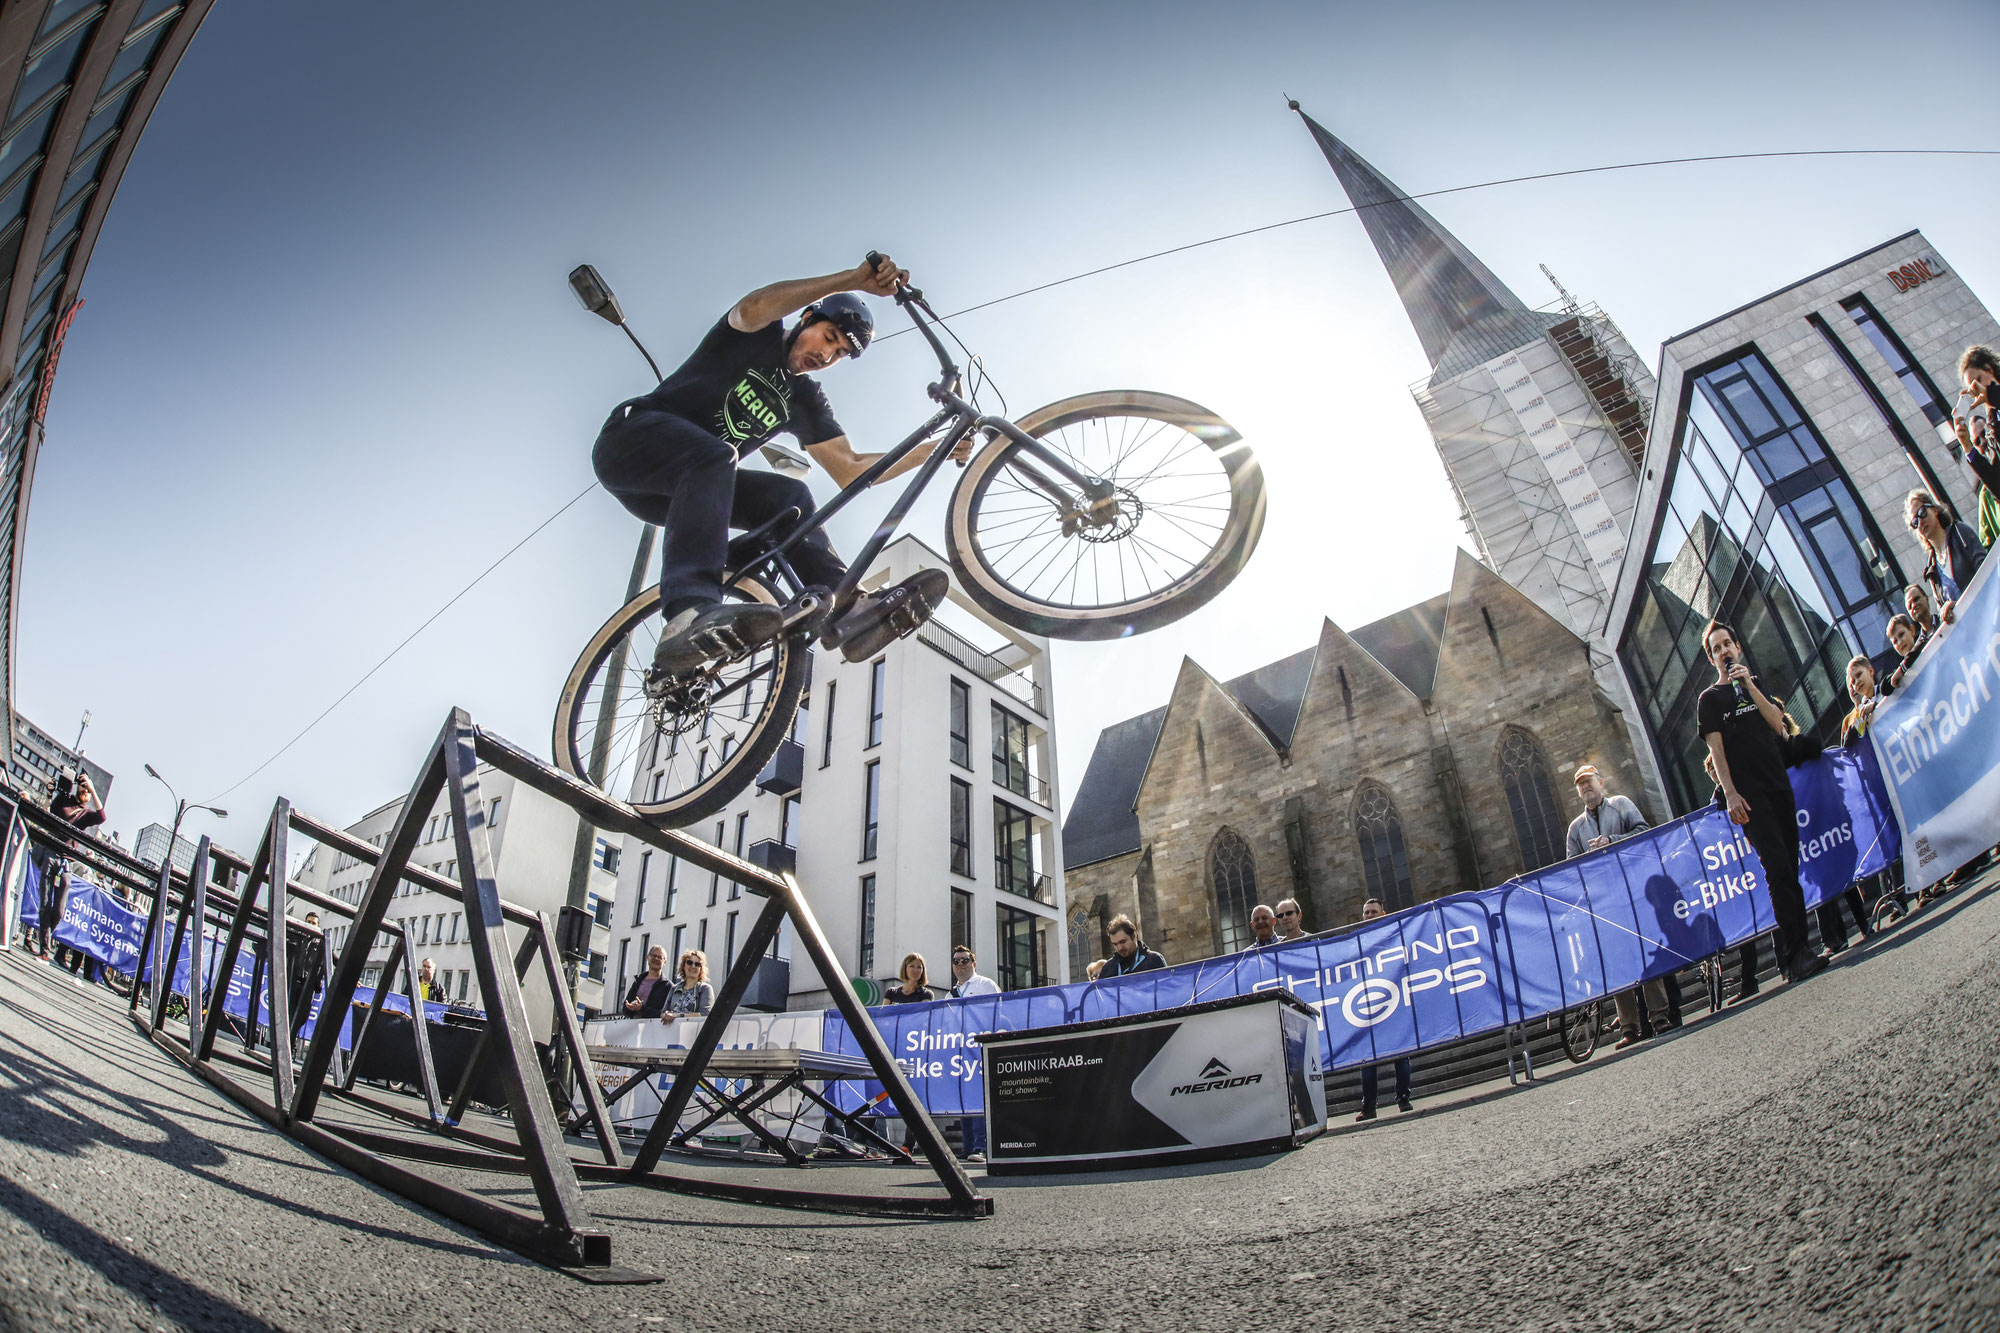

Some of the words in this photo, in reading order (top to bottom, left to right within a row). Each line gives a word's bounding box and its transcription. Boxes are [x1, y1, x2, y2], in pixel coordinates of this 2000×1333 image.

[734, 378, 781, 431] MERID
[1884, 657, 1991, 786] Einfach
[1673, 871, 1756, 919] e-Bike
[72, 897, 123, 933] Shimano
[90, 924, 140, 957] Systems
[997, 1054, 1103, 1074] DOMINIKRAAB.com
[595, 1075, 630, 1088] NERGIE
[1170, 1073, 1262, 1096] MERIDA
[1000, 1141, 1037, 1149] MERIDA.com
